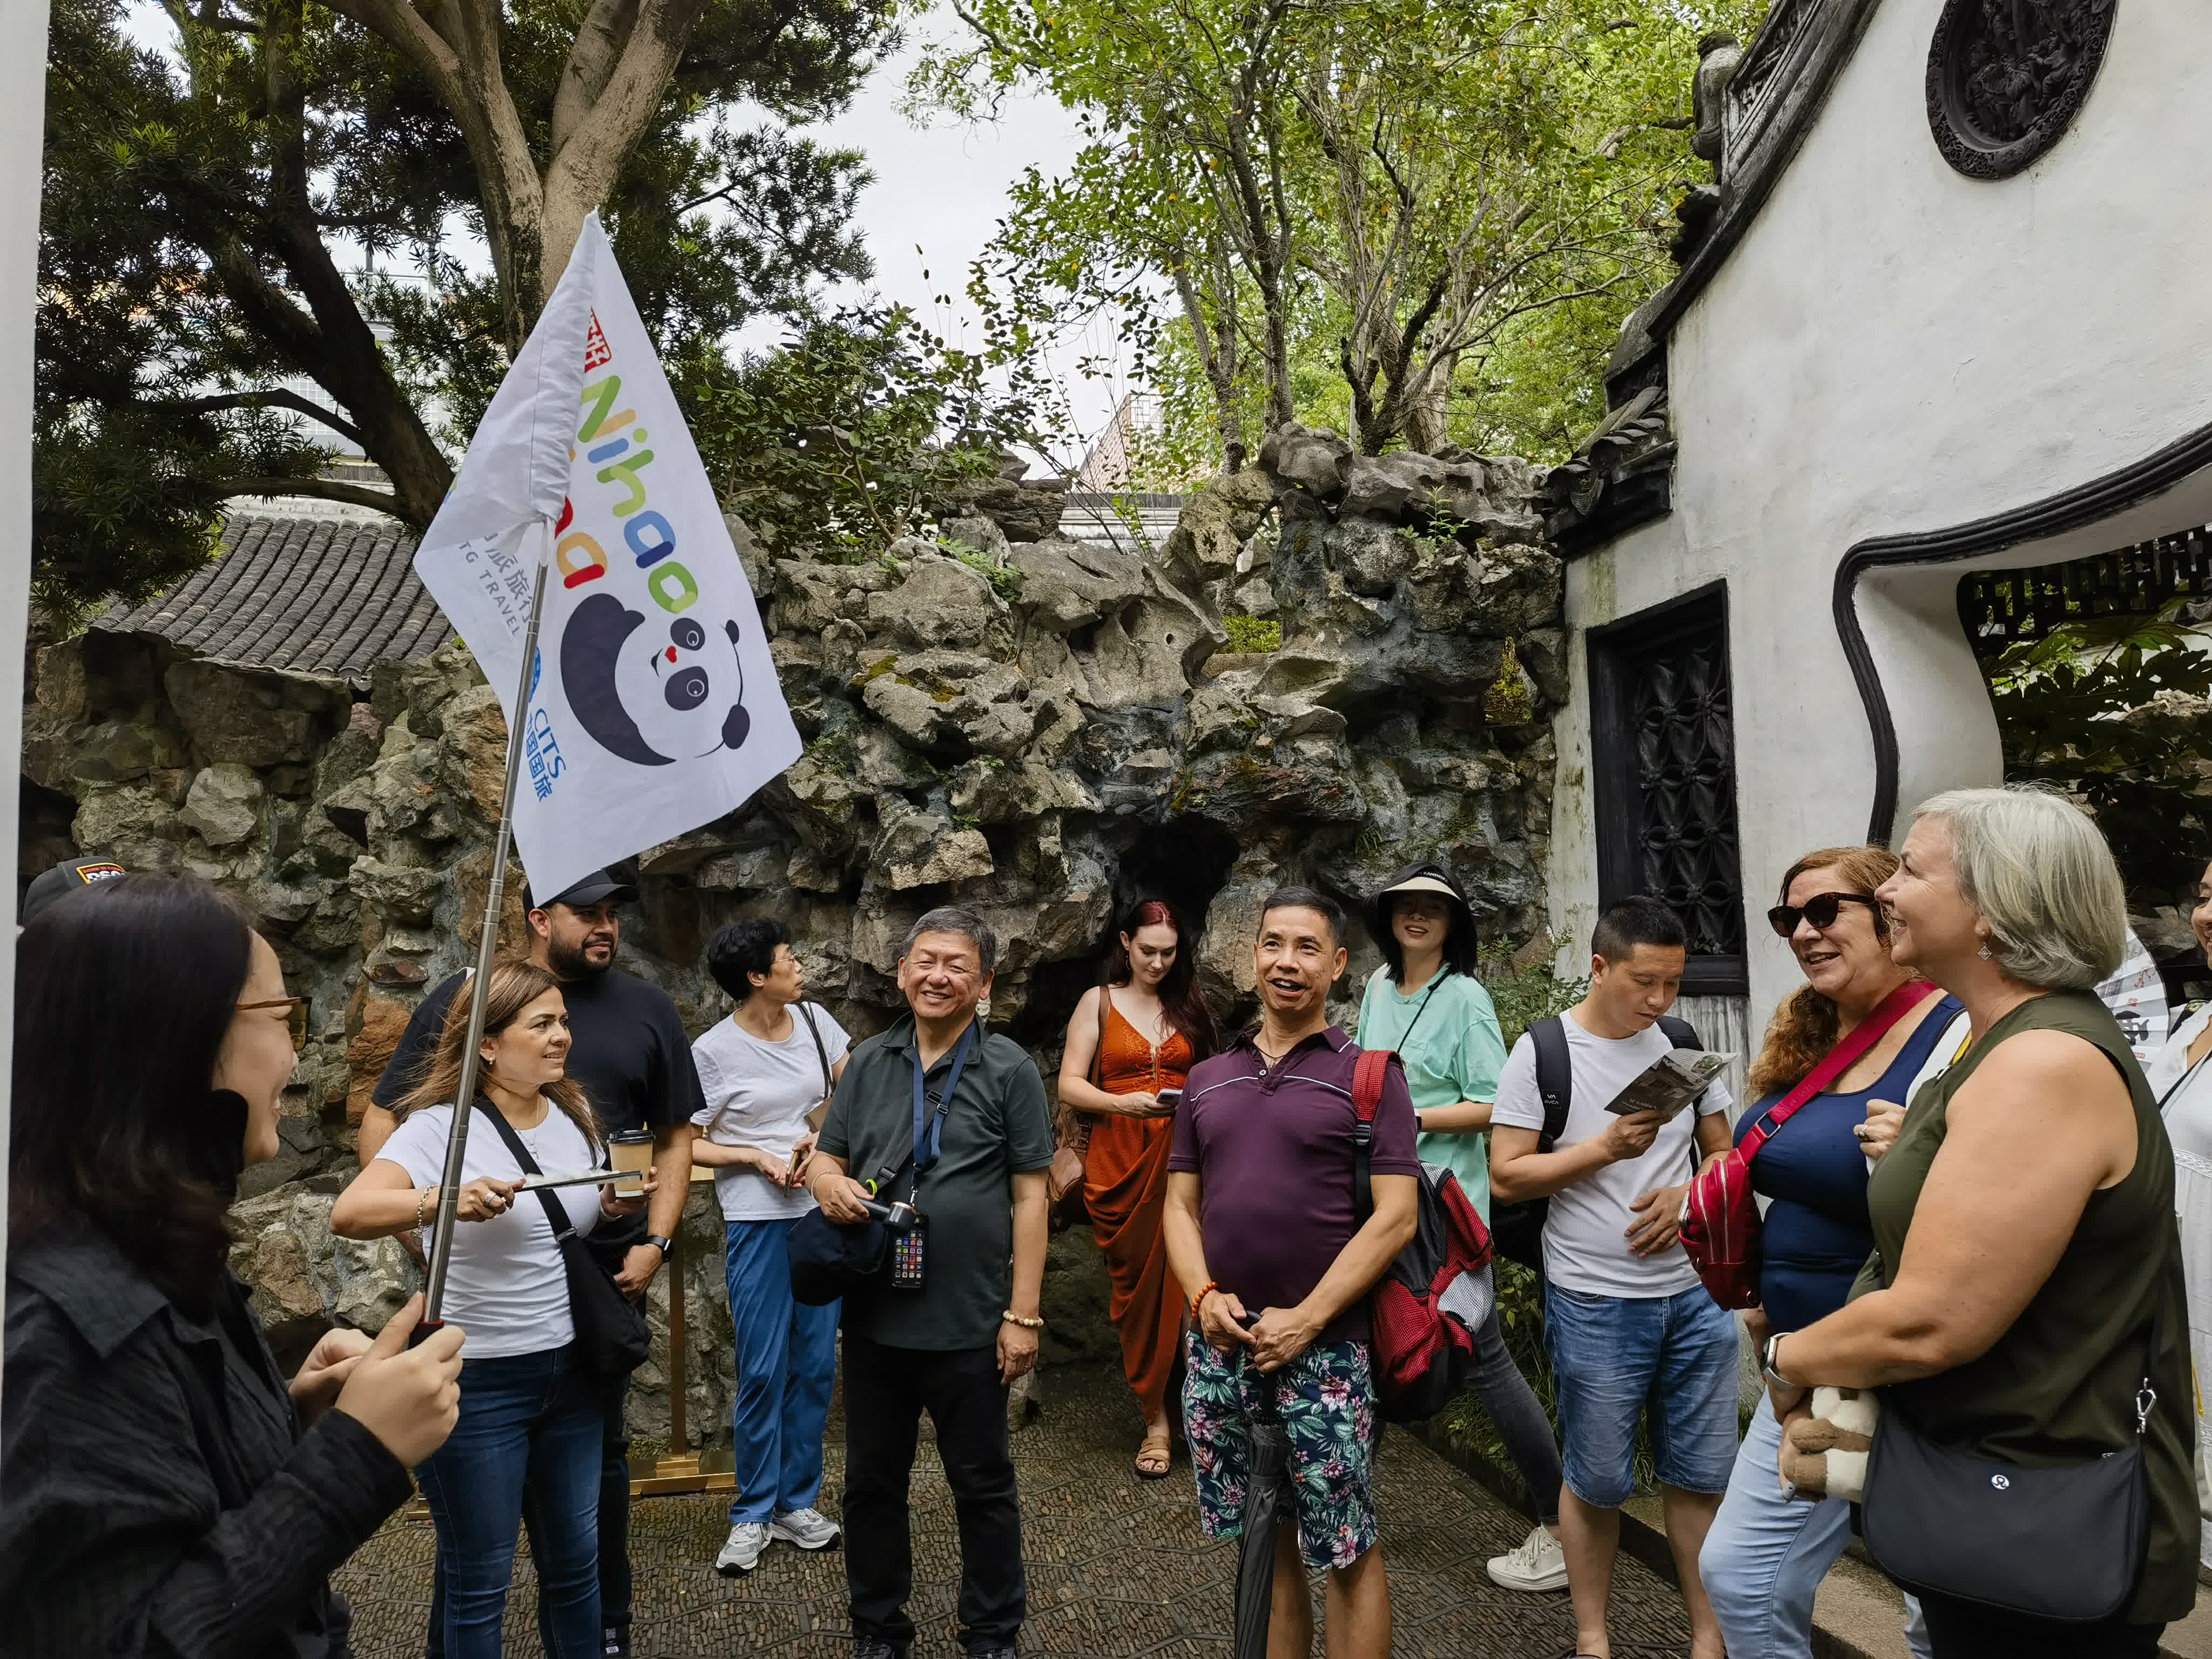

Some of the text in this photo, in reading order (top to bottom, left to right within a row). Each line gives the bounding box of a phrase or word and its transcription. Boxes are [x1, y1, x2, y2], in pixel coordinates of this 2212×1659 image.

[578, 375, 698, 613] Nihao
[459, 542, 520, 637] TG TRAVEL
[535, 709, 566, 778] CITS
